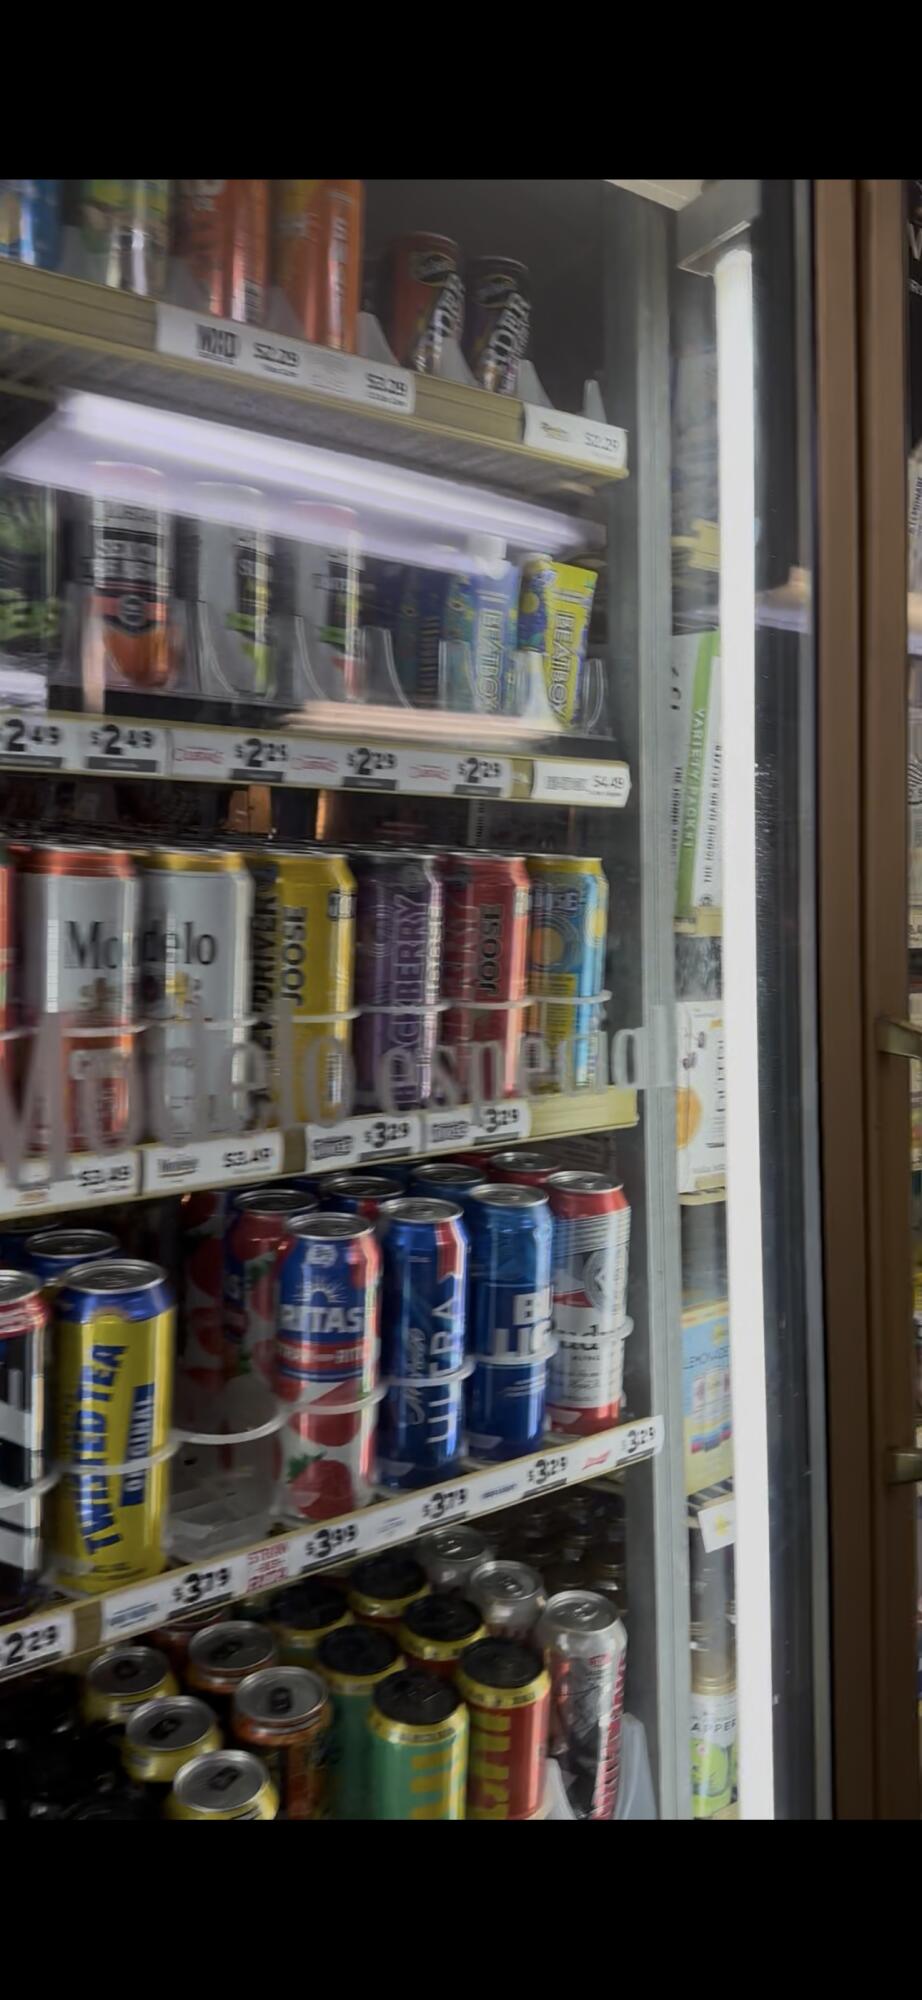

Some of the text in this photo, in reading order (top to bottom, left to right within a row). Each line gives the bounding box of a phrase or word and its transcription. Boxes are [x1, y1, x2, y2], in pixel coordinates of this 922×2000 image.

[686, 708, 705, 779] VARIETY
[281, 906, 308, 1007] JOOSE
[479, 905, 502, 995] JOOSE
[426, 1296, 465, 1447] ULTRA
[71, 1344, 130, 1556] TWISTED TEA
[126, 1394, 154, 1493] ORGINAL
